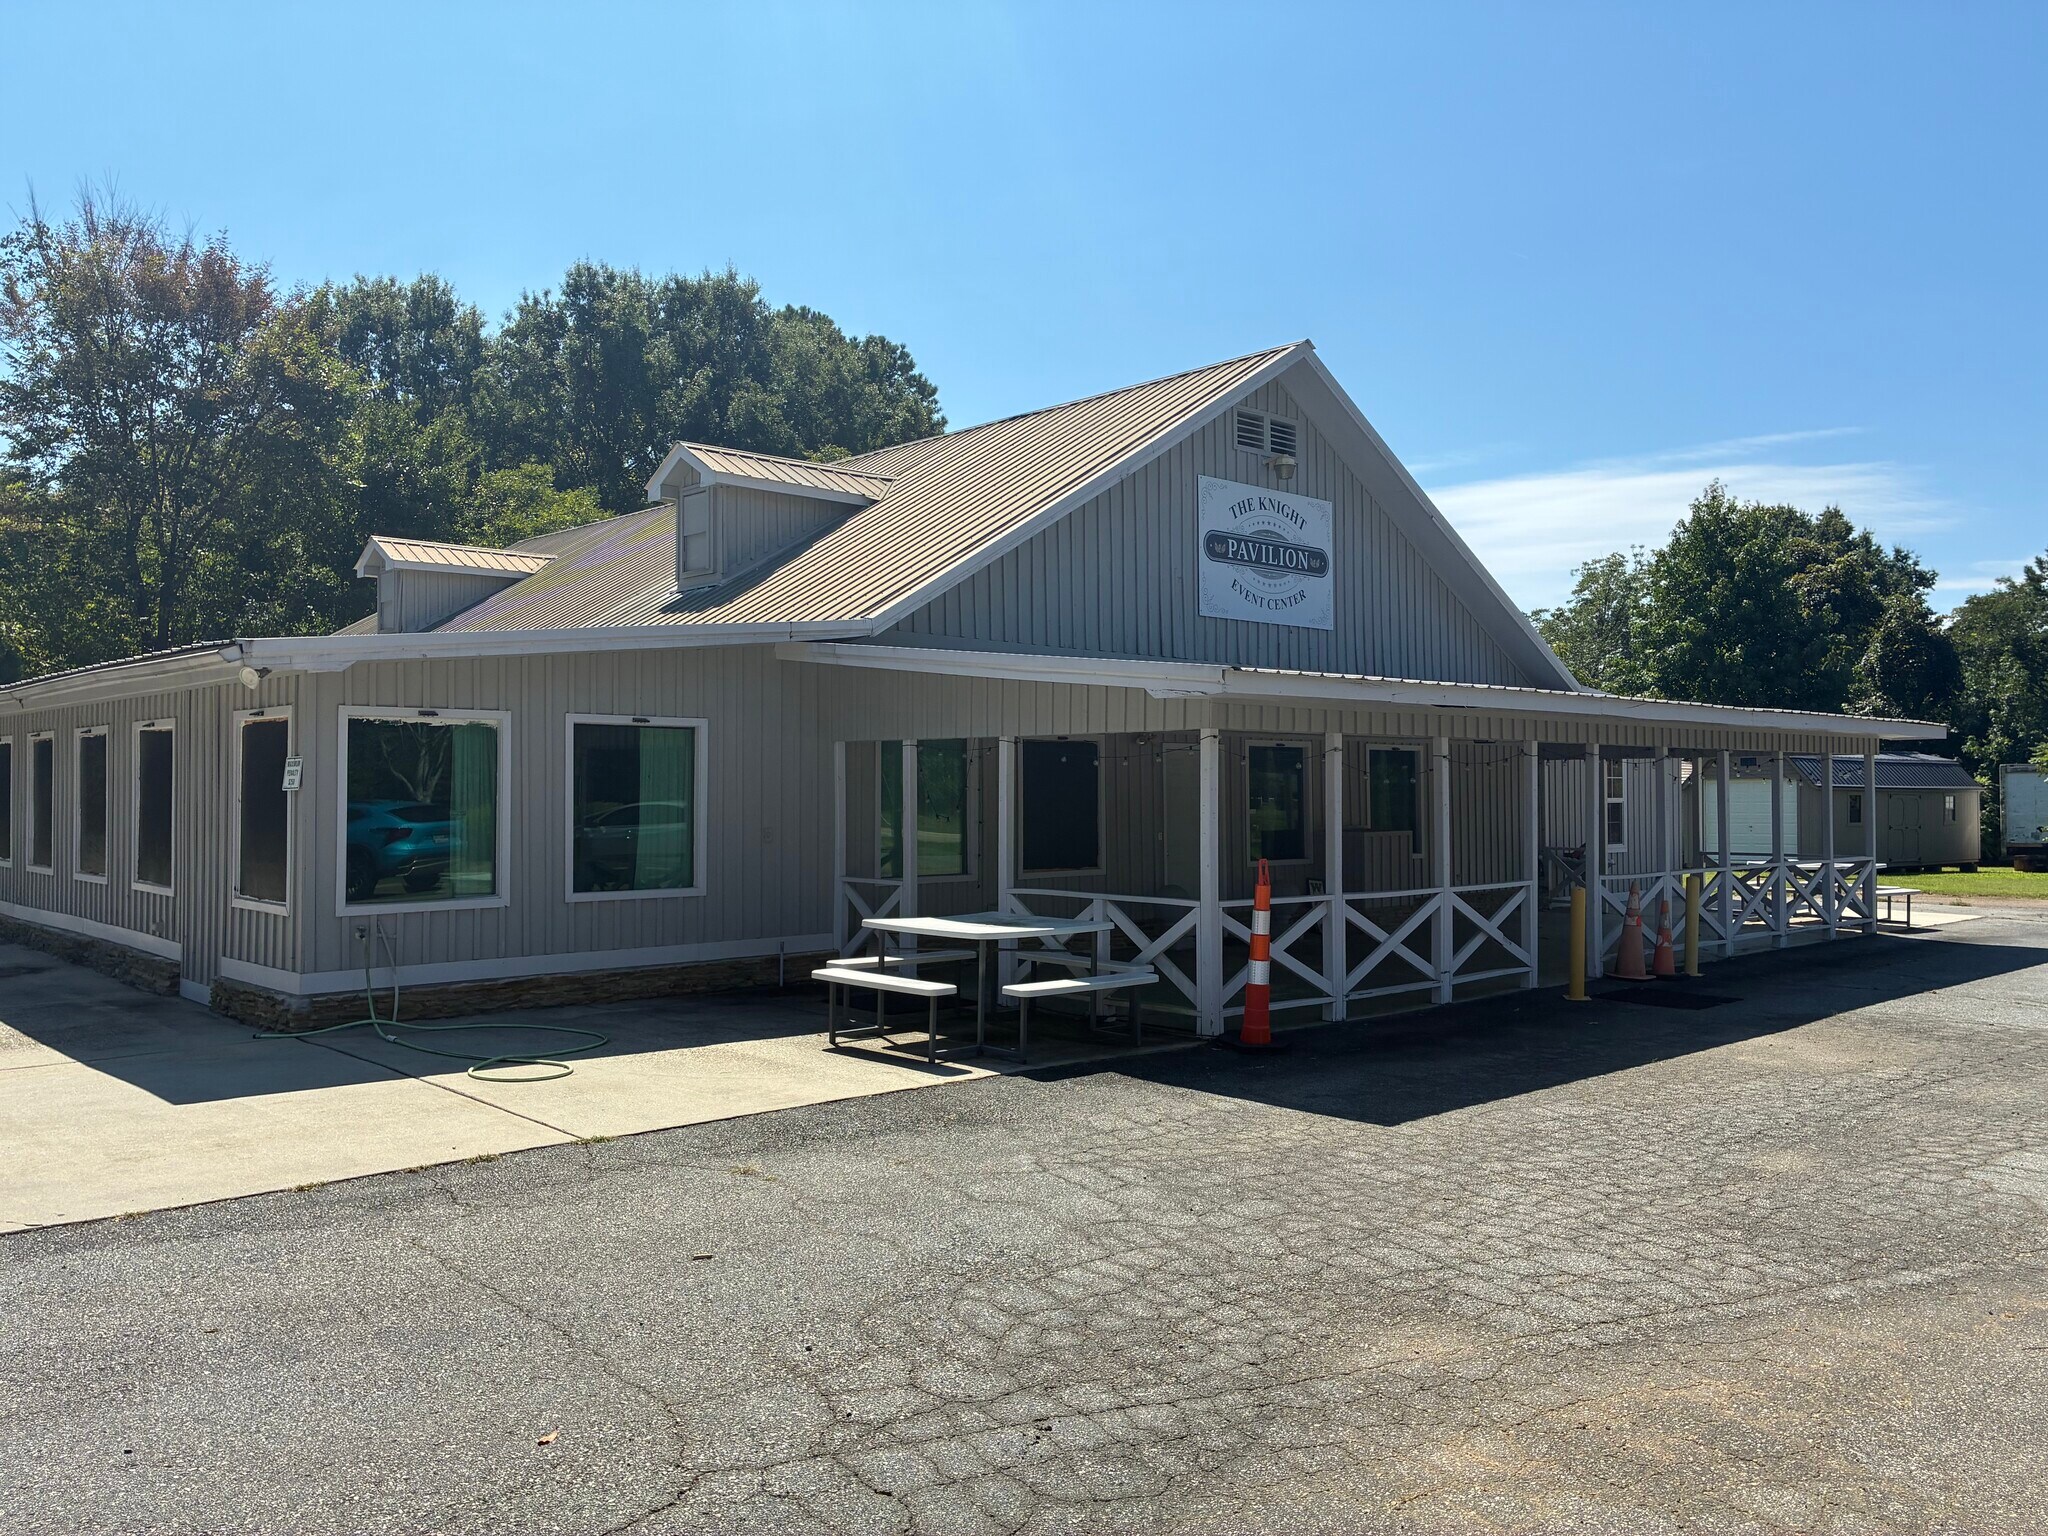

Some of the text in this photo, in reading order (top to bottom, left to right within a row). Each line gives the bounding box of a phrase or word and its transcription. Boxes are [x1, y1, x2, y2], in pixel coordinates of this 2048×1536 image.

[1229, 497, 1308, 530] THE KNIGHT
[1227, 538, 1309, 570] PAVILION
[1231, 578, 1307, 610] EVENT CENTER
